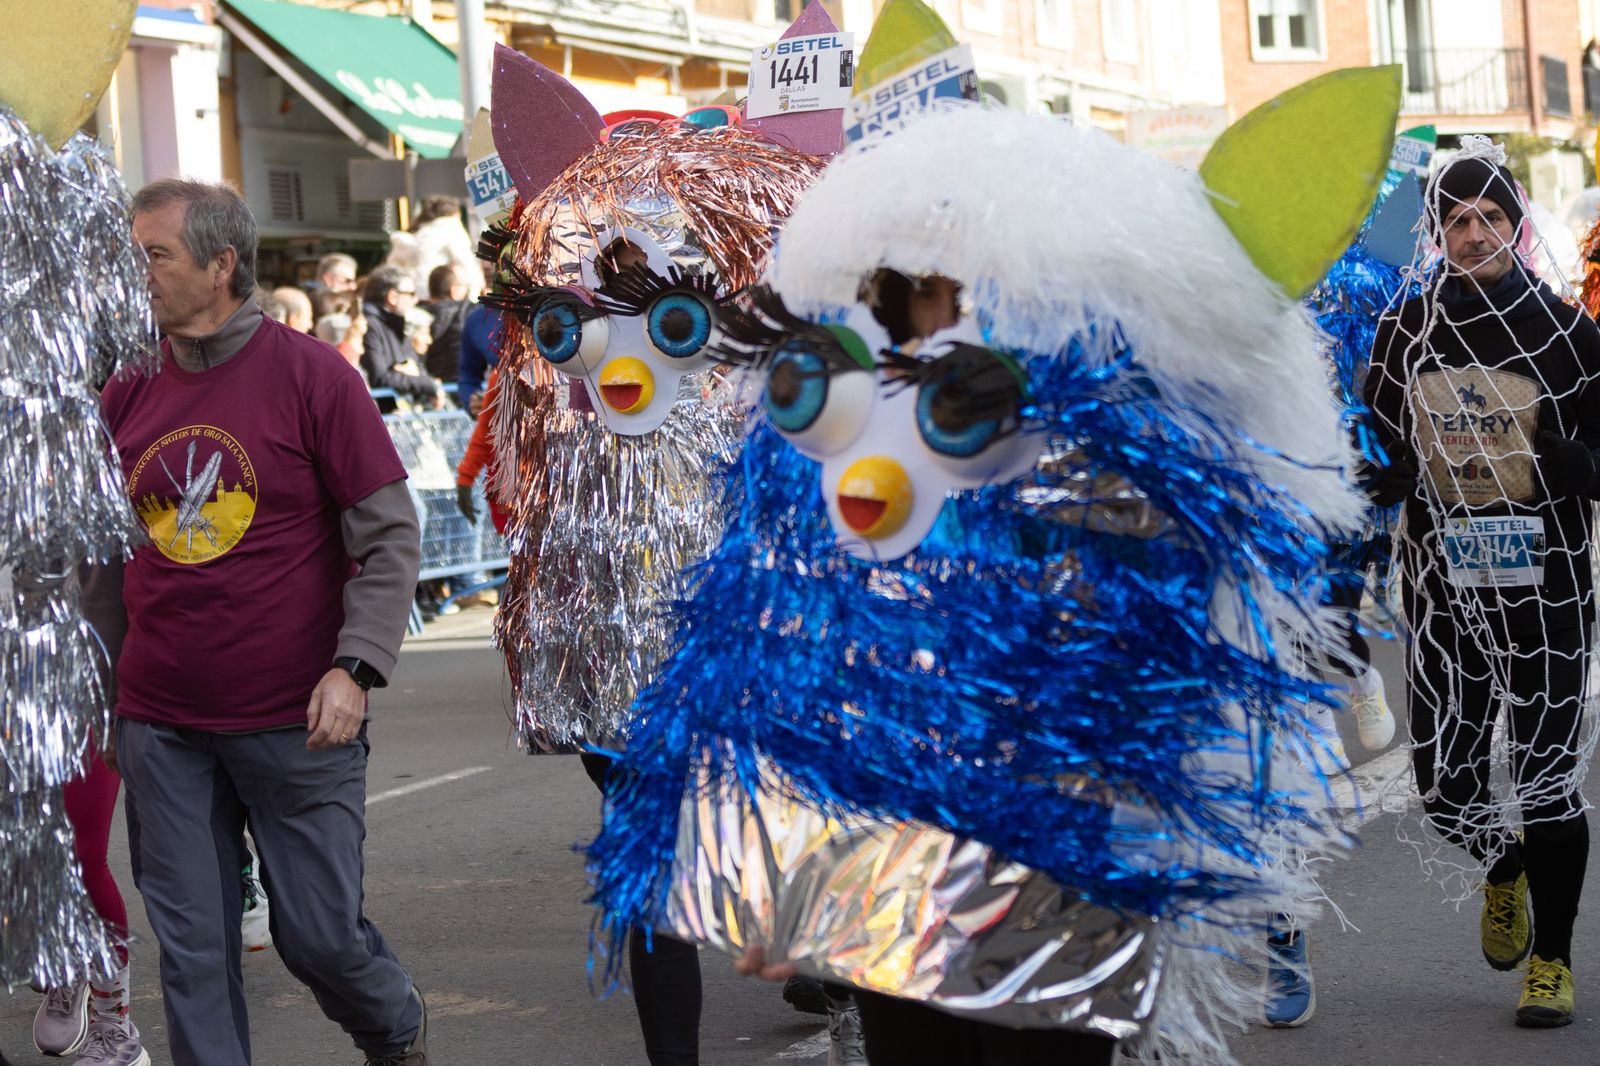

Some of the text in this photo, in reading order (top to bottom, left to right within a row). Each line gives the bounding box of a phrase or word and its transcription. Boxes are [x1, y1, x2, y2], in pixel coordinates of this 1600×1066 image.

[777, 36, 844, 55] SETEL
[770, 54, 819, 89] 1441
[875, 58, 959, 106] SETEL
[479, 156, 500, 172] SE
[474, 166, 509, 200] 547
[1441, 434, 1500, 447] CENTENRIO
[160, 430, 189, 447] SIGLOS
[191, 428, 202, 436] DE
[203, 428, 222, 441] ORO
[220, 436, 253, 488] SALAMANCA
[1469, 519, 1535, 533] SETEL
